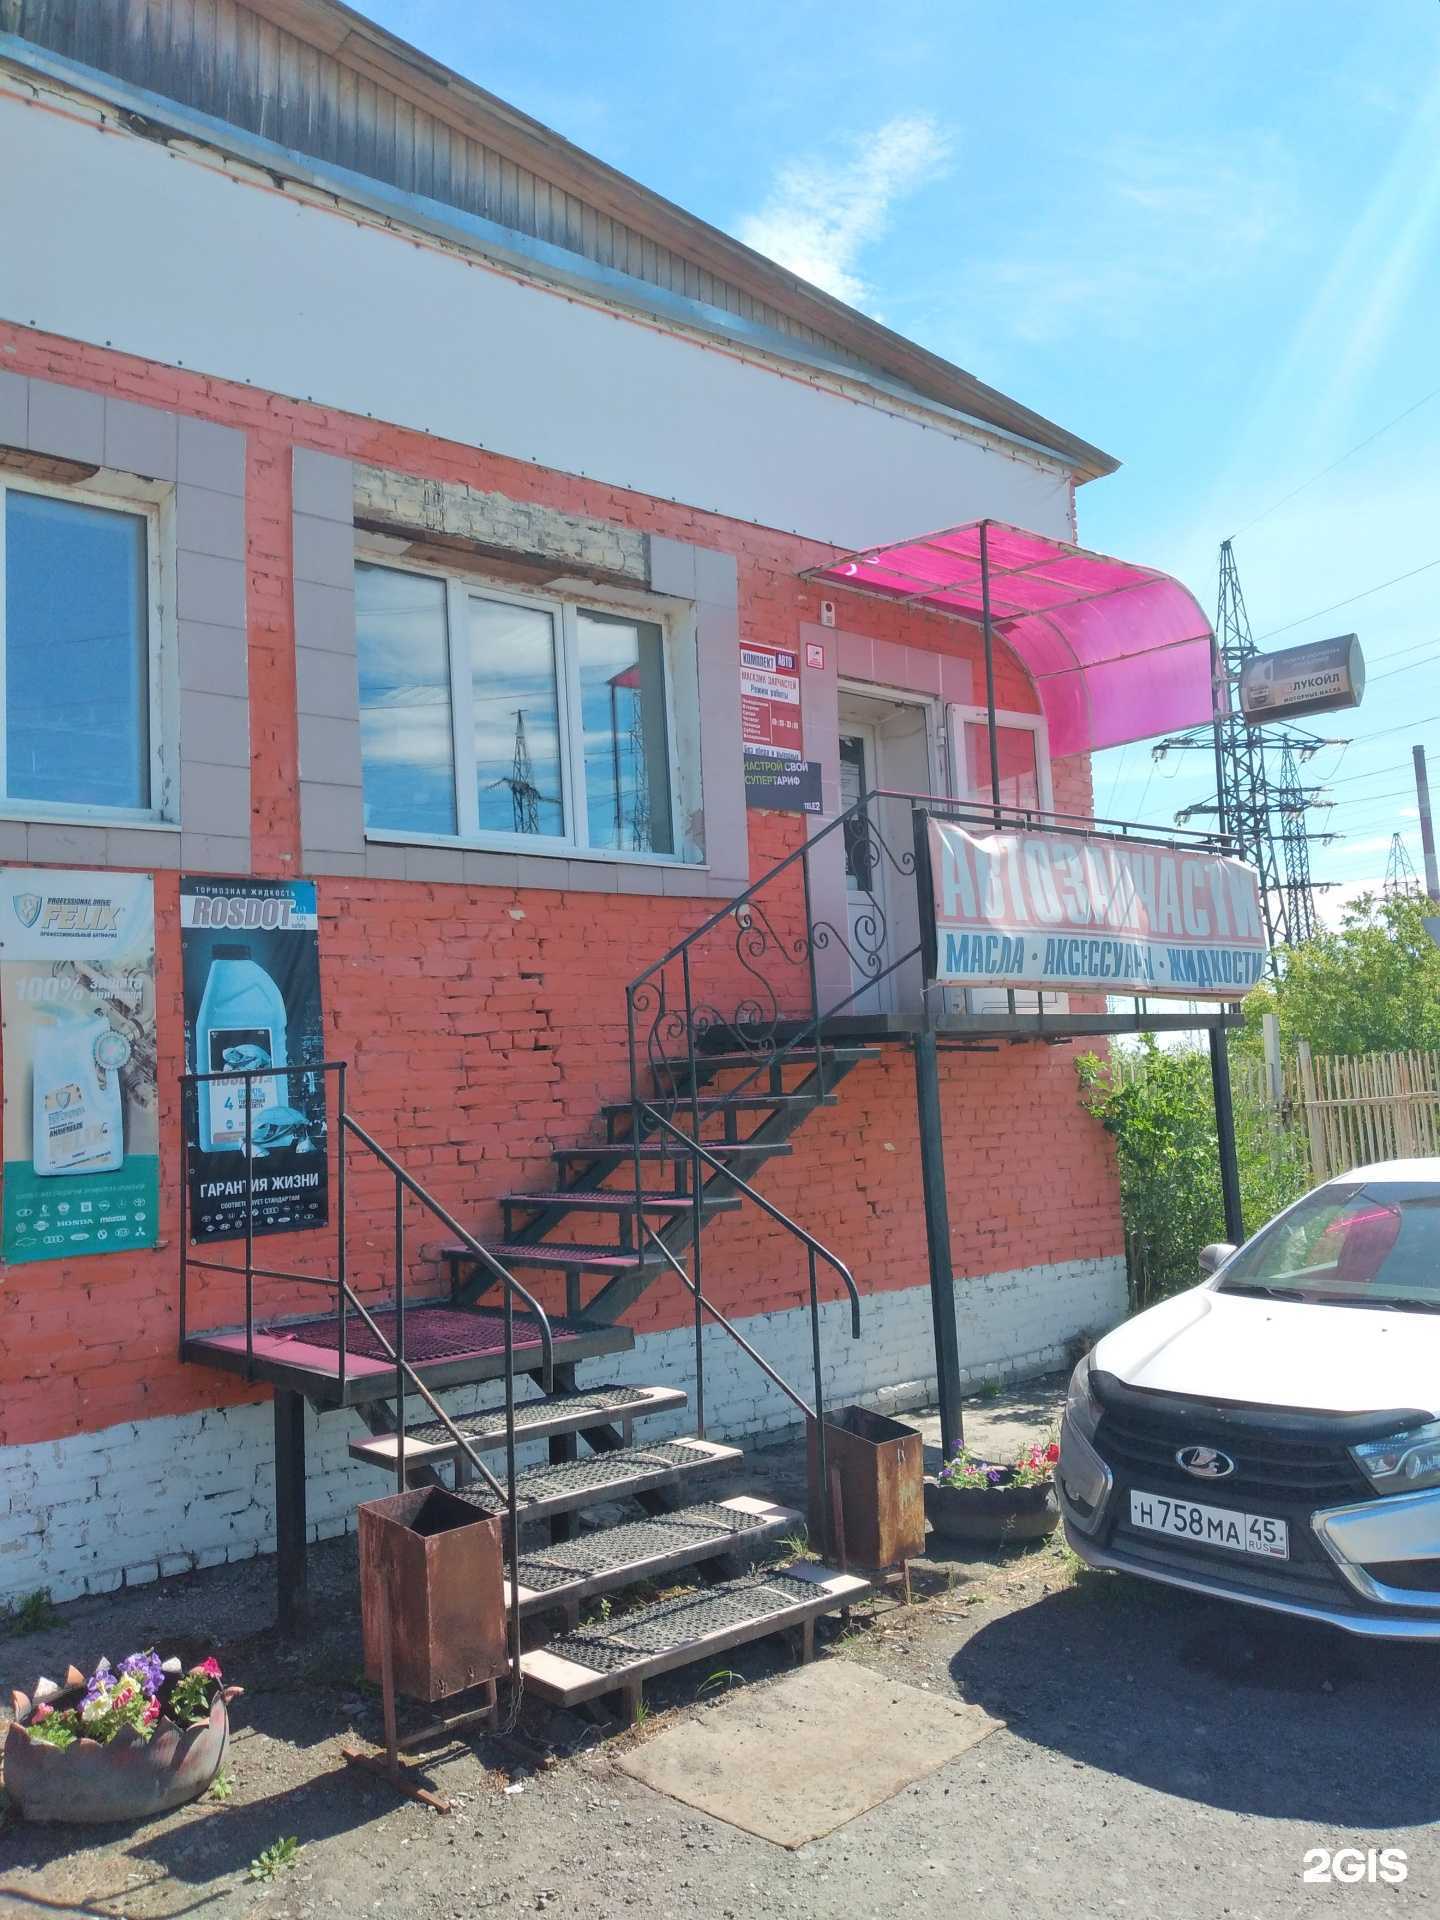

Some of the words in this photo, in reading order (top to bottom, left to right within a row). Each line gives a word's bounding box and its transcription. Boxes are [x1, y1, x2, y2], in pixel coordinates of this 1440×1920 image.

[777, 653, 793, 668] АВТО
[1292, 672, 1341, 691] ЛУКОЙЛ
[784, 760, 808, 772] СВОЙ
[744, 775, 801, 786] СУПЕРТАРИФ
[804, 801, 820, 811] TELE2
[195, 886, 247, 896] ТОРМОЗНАЯ
[250, 888, 296, 898] ЖИДКОСТЬ
[47, 897, 92, 905] PROFESSIONAL
[93, 898, 112, 906] DRIVE
[41, 904, 120, 931] FELIX
[192, 896, 296, 929] ROSDOT
[945, 933, 1025, 974] МАСЛА
[1043, 938, 1155, 981] АКСЕССУАРЫ
[1167, 947, 1264, 988] ЖИДКОСТИ
[16, 976, 83, 1001] 100%
[271, 1172, 319, 1190] ЖИЗНИ
[56, 1217, 94, 1227] HONDA
[1248, 1540, 1271, 1552] RUS
